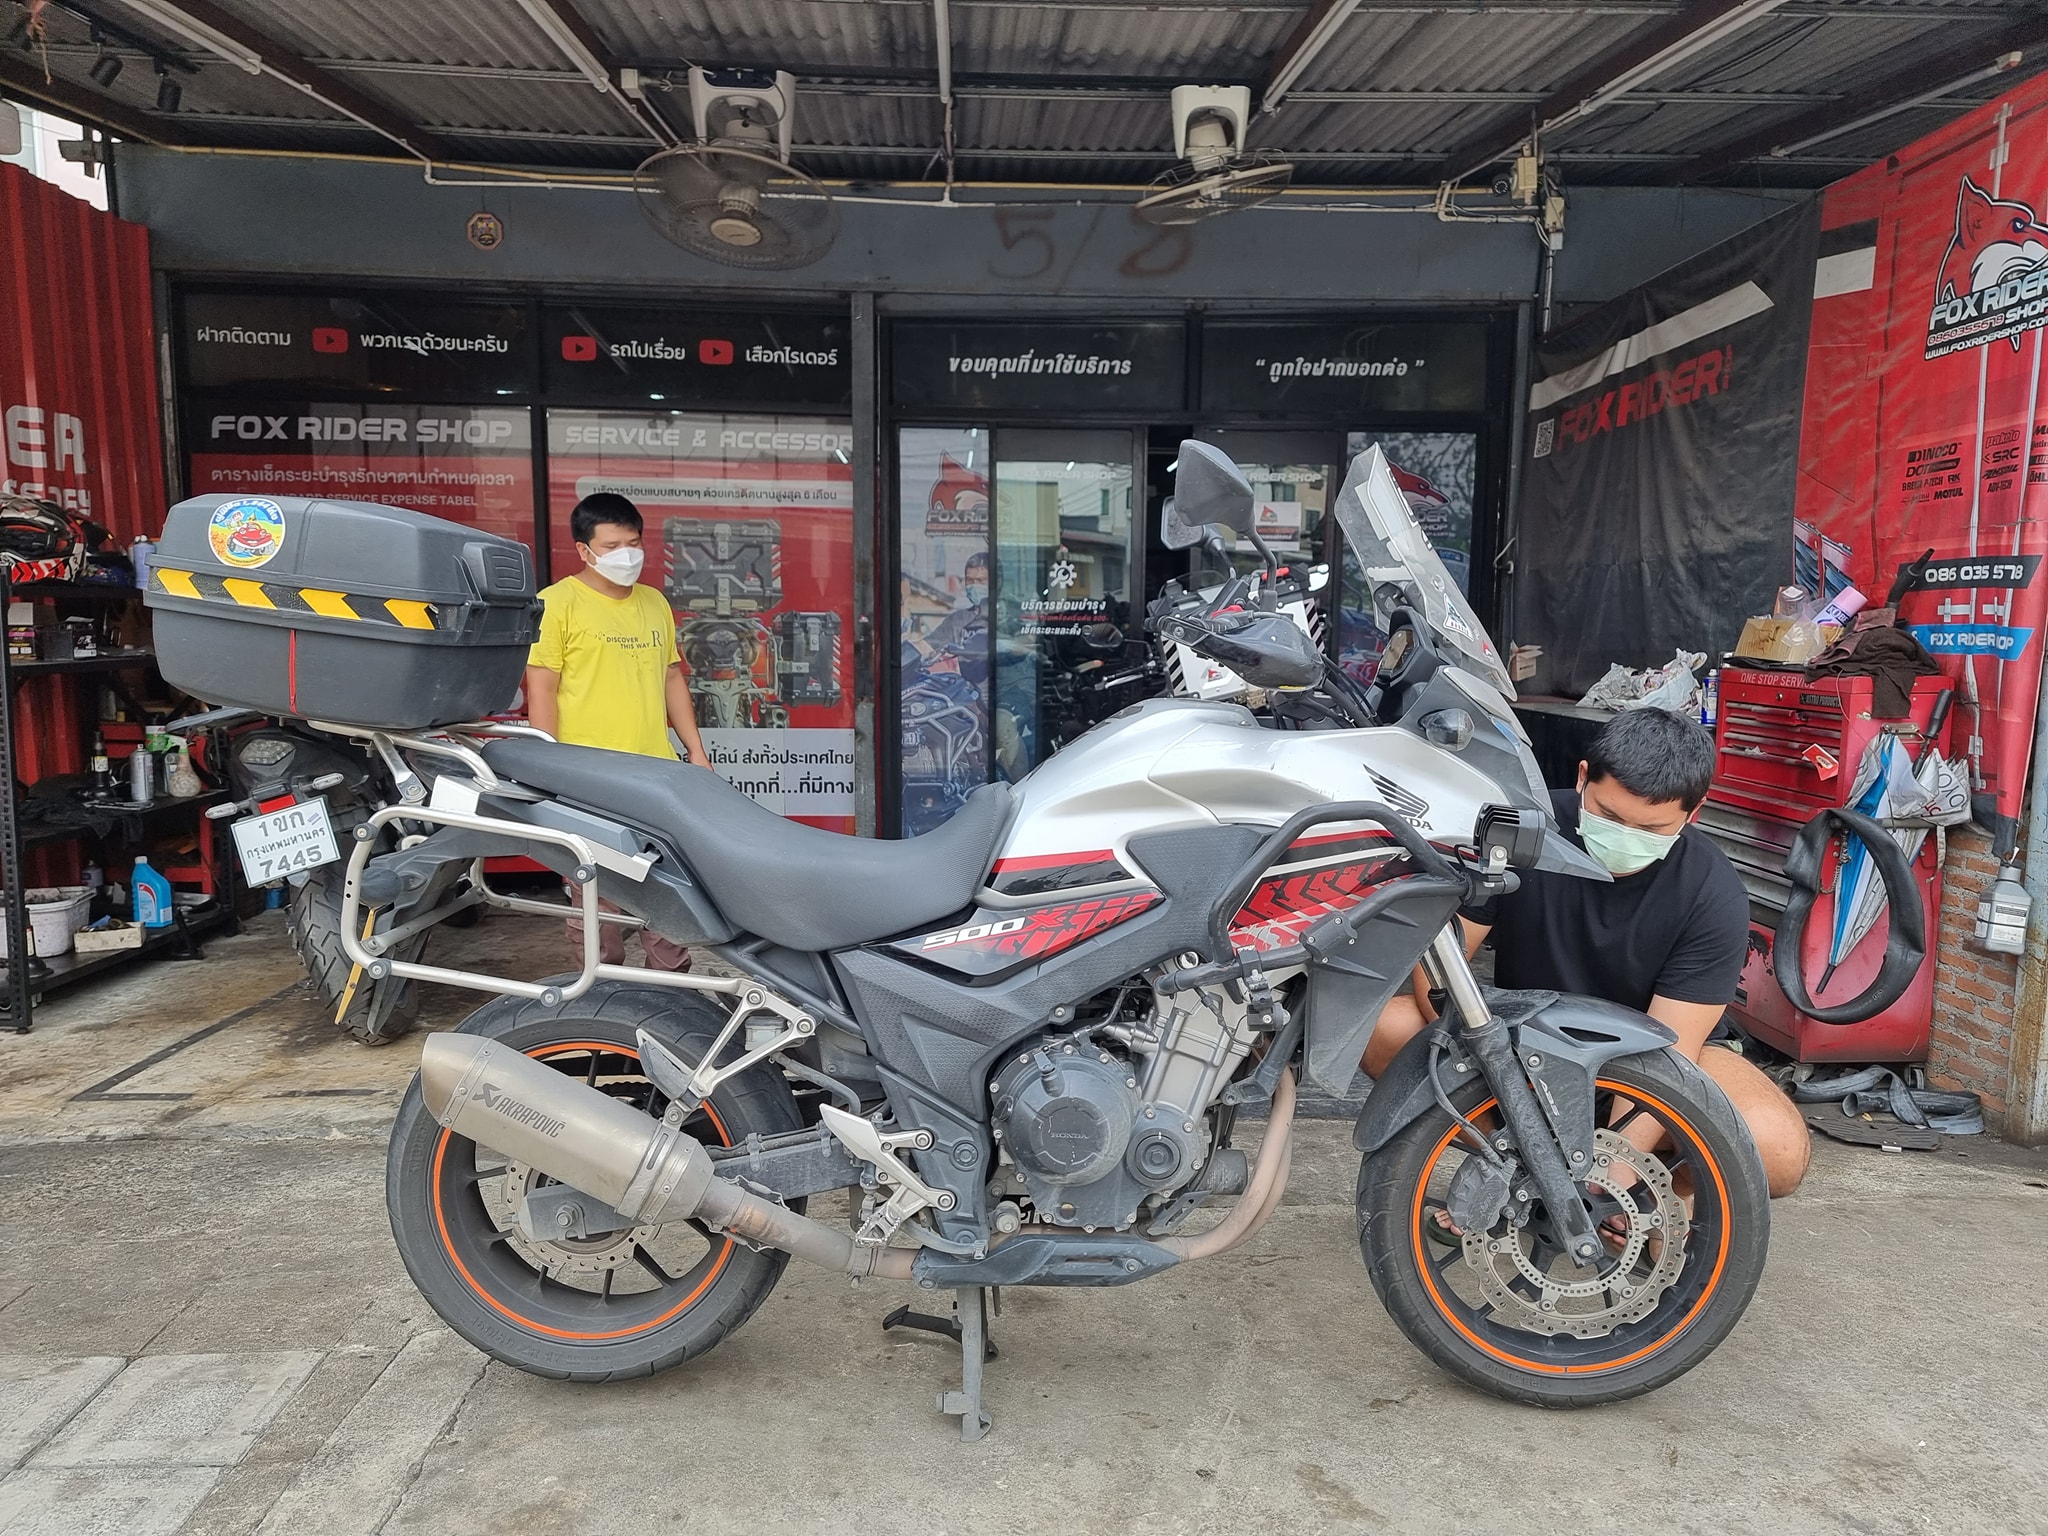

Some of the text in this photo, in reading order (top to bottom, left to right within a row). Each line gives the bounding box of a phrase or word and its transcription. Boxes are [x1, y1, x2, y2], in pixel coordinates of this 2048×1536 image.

[1929, 292, 1981, 331] FOX
[197, 326, 508, 353] ฝากติดตาม พวกเราด้วยนะครับ
[610, 337, 686, 361] รถไปเรื่อย
[746, 346, 839, 367] เสือกไรเดอร์
[949, 348, 1132, 380] ขอบคุณที่มาใช้บริการ
[1616, 350, 1723, 427] RIDER
[211, 415, 512, 444] FOX RIDER SHOP
[565, 426, 680, 447] SERVICE
[692, 429, 706, 447] &
[1992, 447, 2020, 463] SRC
[1288, 473, 1322, 482] SHOP
[382, 495, 437, 505] EXPENSE
[440, 495, 478, 506] TABEL
[1934, 487, 1964, 500] MOTUL
[927, 510, 961, 522] FOX
[1925, 567, 1957, 583] 086
[1960, 565, 1990, 580] 035
[1020, 598, 1107, 614] บริการซ่อมบำรุง
[651, 630, 663, 647] R
[1741, 672, 1757, 684] ONE
[1758, 674, 1779, 686] STOP
[246, 827, 326, 859] กรุงเทพมหานคร
[259, 844, 322, 878] 7445
[922, 911, 1065, 951] 500X
[494, 1096, 567, 1139] AKRAPOVIČ
[1050, 1132, 1089, 1140] HONDA
